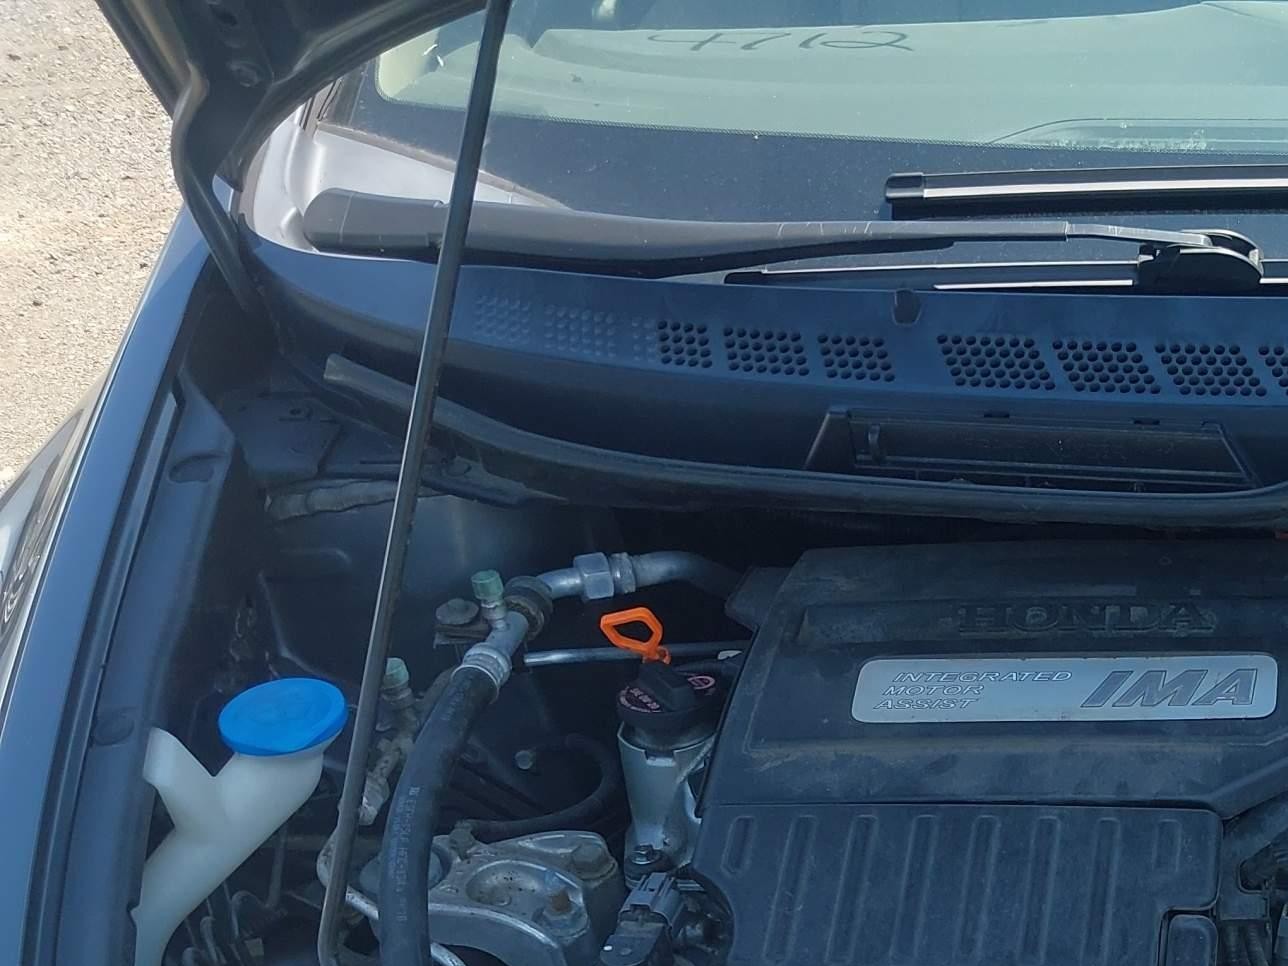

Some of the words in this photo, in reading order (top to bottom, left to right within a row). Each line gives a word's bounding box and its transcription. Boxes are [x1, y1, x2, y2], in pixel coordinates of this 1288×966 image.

[647, 30, 915, 52] 4712
[958, 604, 1217, 634] HONDA
[892, 671, 1074, 682] INTEGRATED
[881, 685, 985, 696] MOTOR
[1079, 668, 1259, 708] IMA
[873, 698, 979, 710] ASSIST
